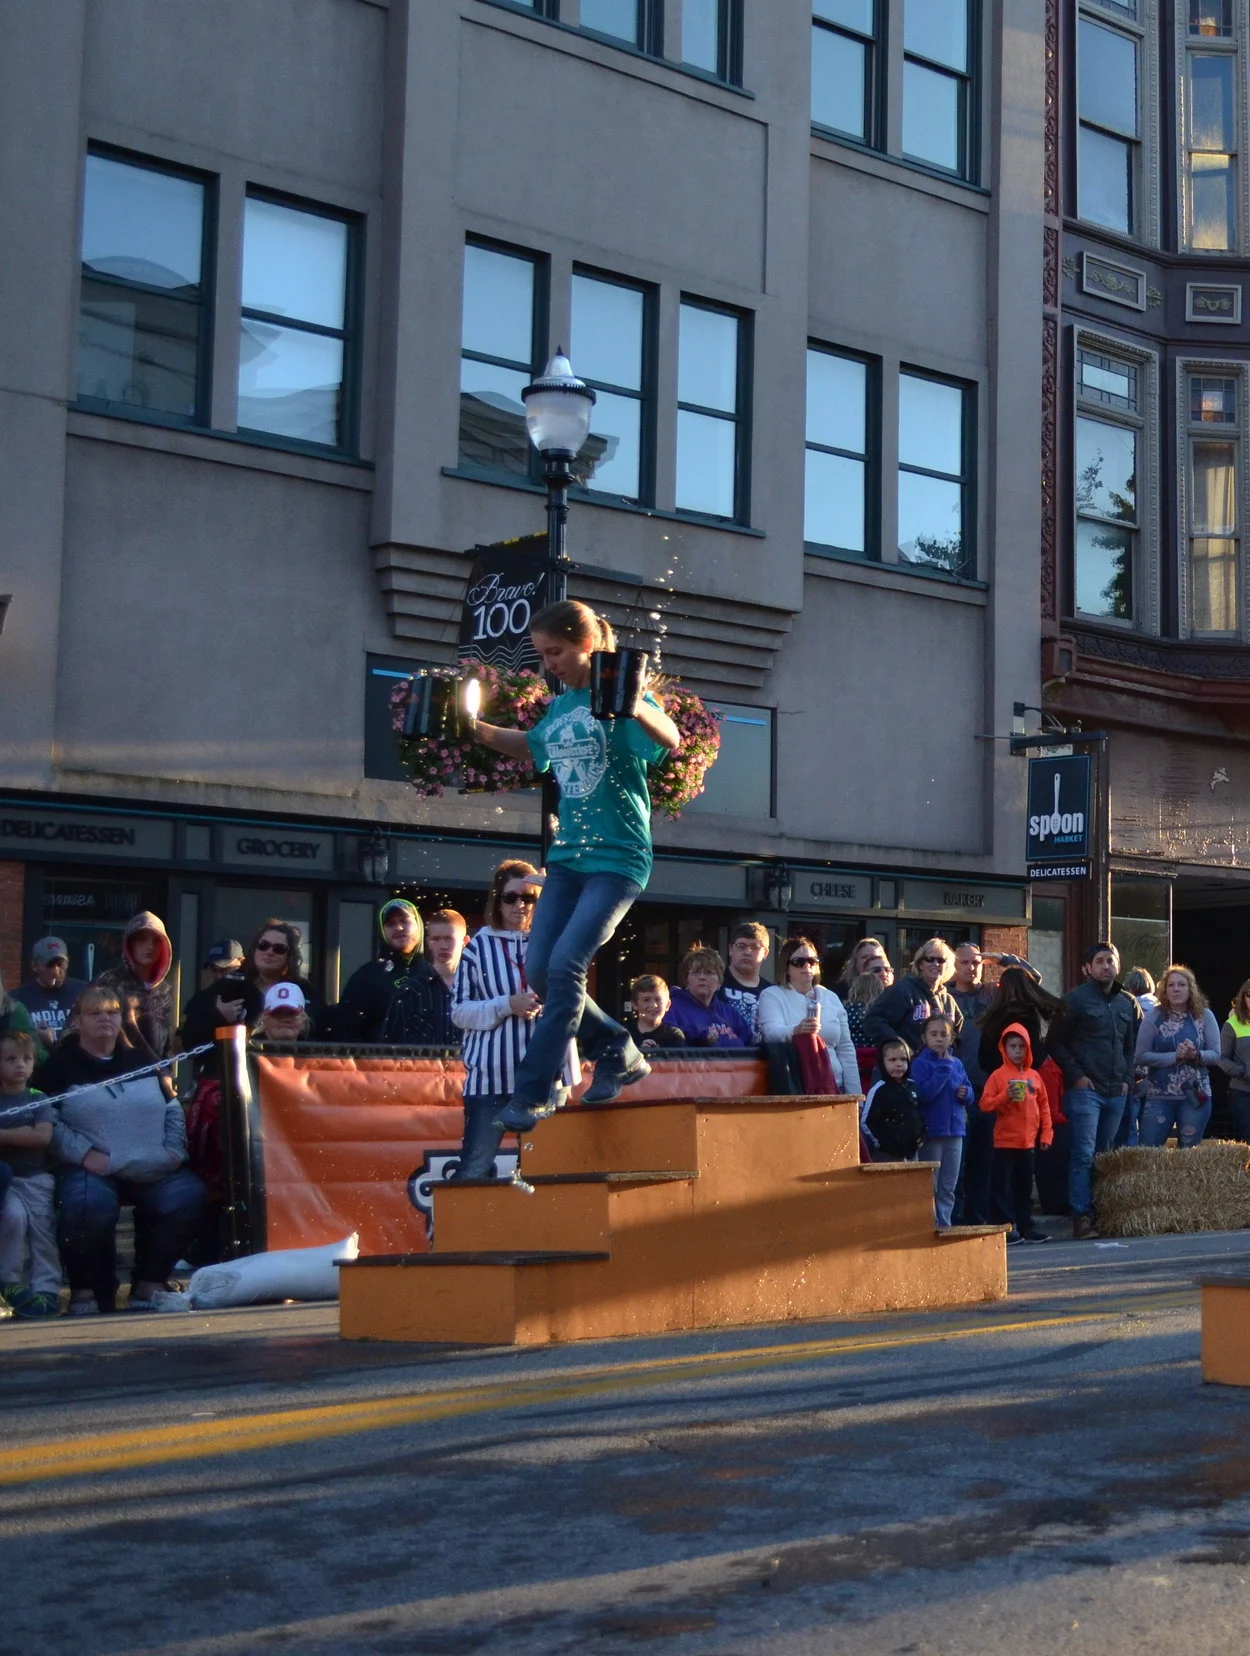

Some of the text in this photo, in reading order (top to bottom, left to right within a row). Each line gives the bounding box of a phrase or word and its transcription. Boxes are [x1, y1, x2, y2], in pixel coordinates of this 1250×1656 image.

[467, 572, 545, 606] Bravo!
[473, 599, 531, 640] 100
[1, 818, 136, 847] DELICATESSEN
[1029, 812, 1084, 842] spoon
[1054, 834, 1083, 844] MARKET
[236, 838, 321, 860] GROCERY
[1030, 866, 1087, 878] DELICATESSEN
[810, 881, 856, 899] CHEESE
[943, 891, 986, 908] BAKERY
[724, 986, 757, 1005] US
[30, 1009, 72, 1024] NDIA
